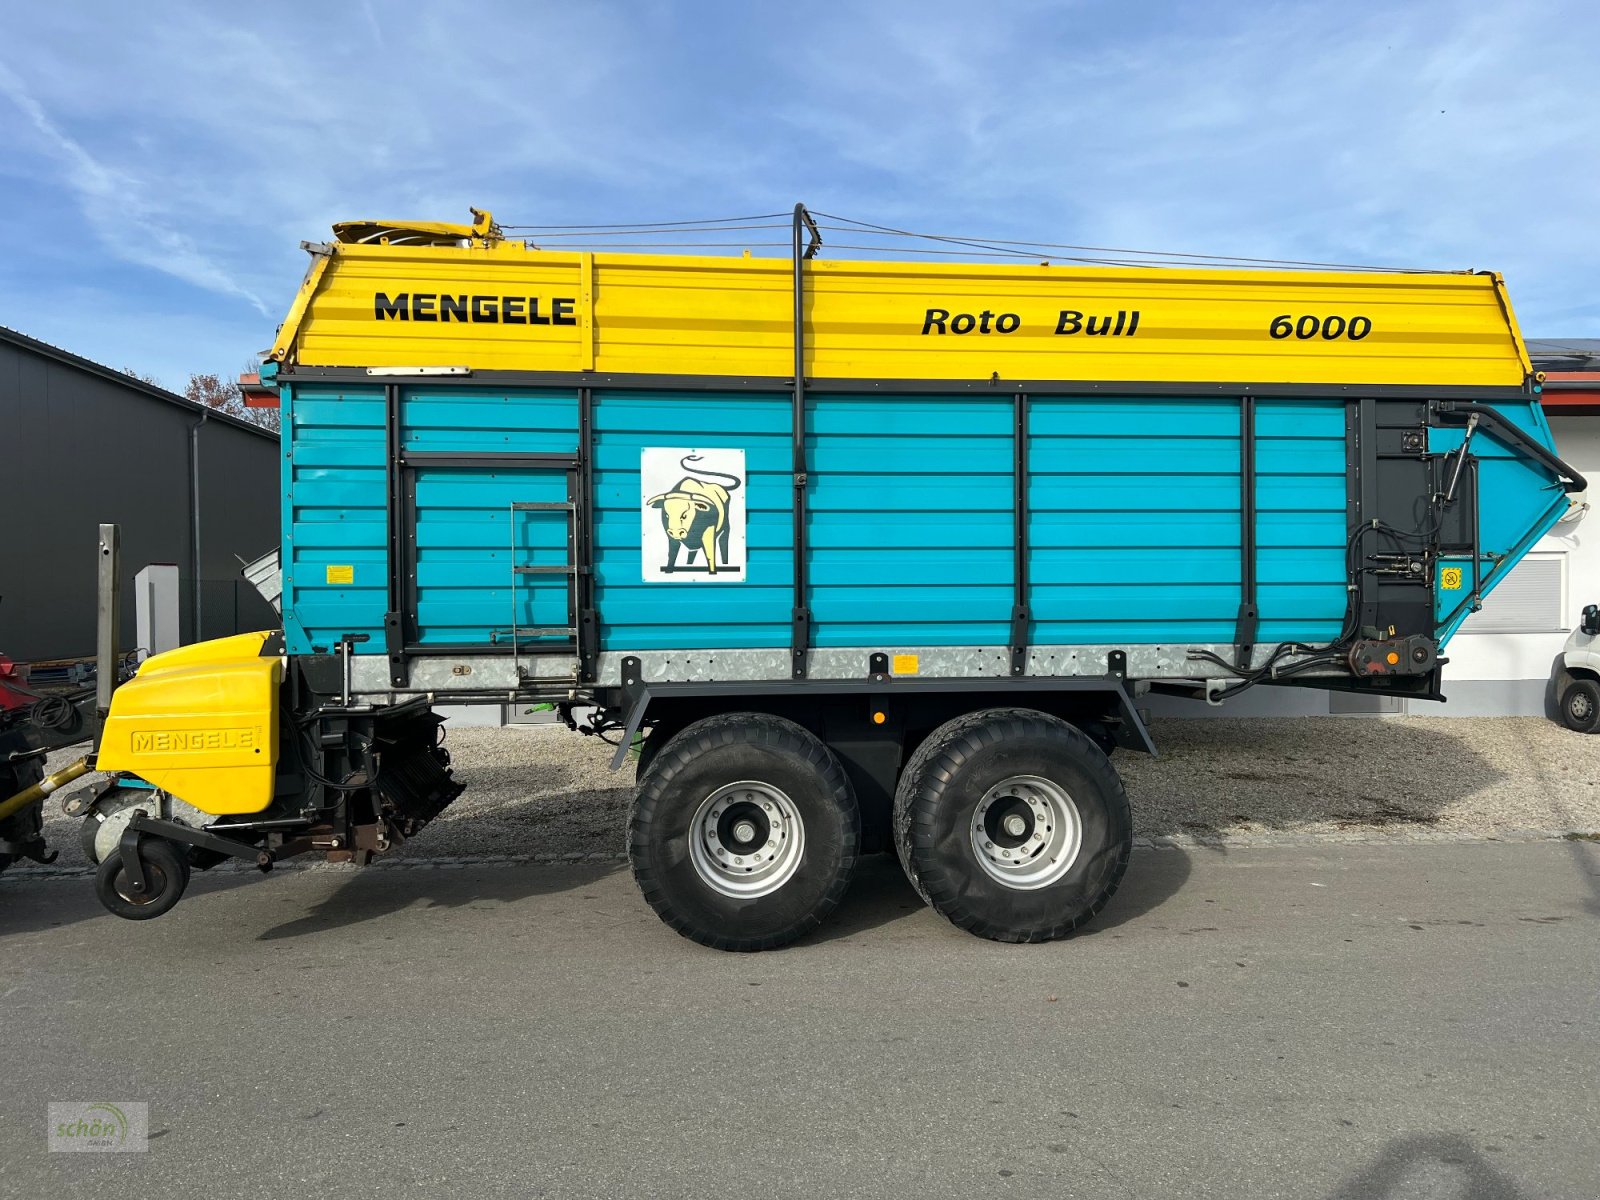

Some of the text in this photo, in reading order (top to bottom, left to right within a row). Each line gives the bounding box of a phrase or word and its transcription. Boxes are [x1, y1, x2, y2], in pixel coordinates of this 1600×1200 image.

[375, 292, 577, 326] MENGELE
[921, 308, 1372, 340] Roto Bull 6000
[135, 731, 253, 752] MENGELE
